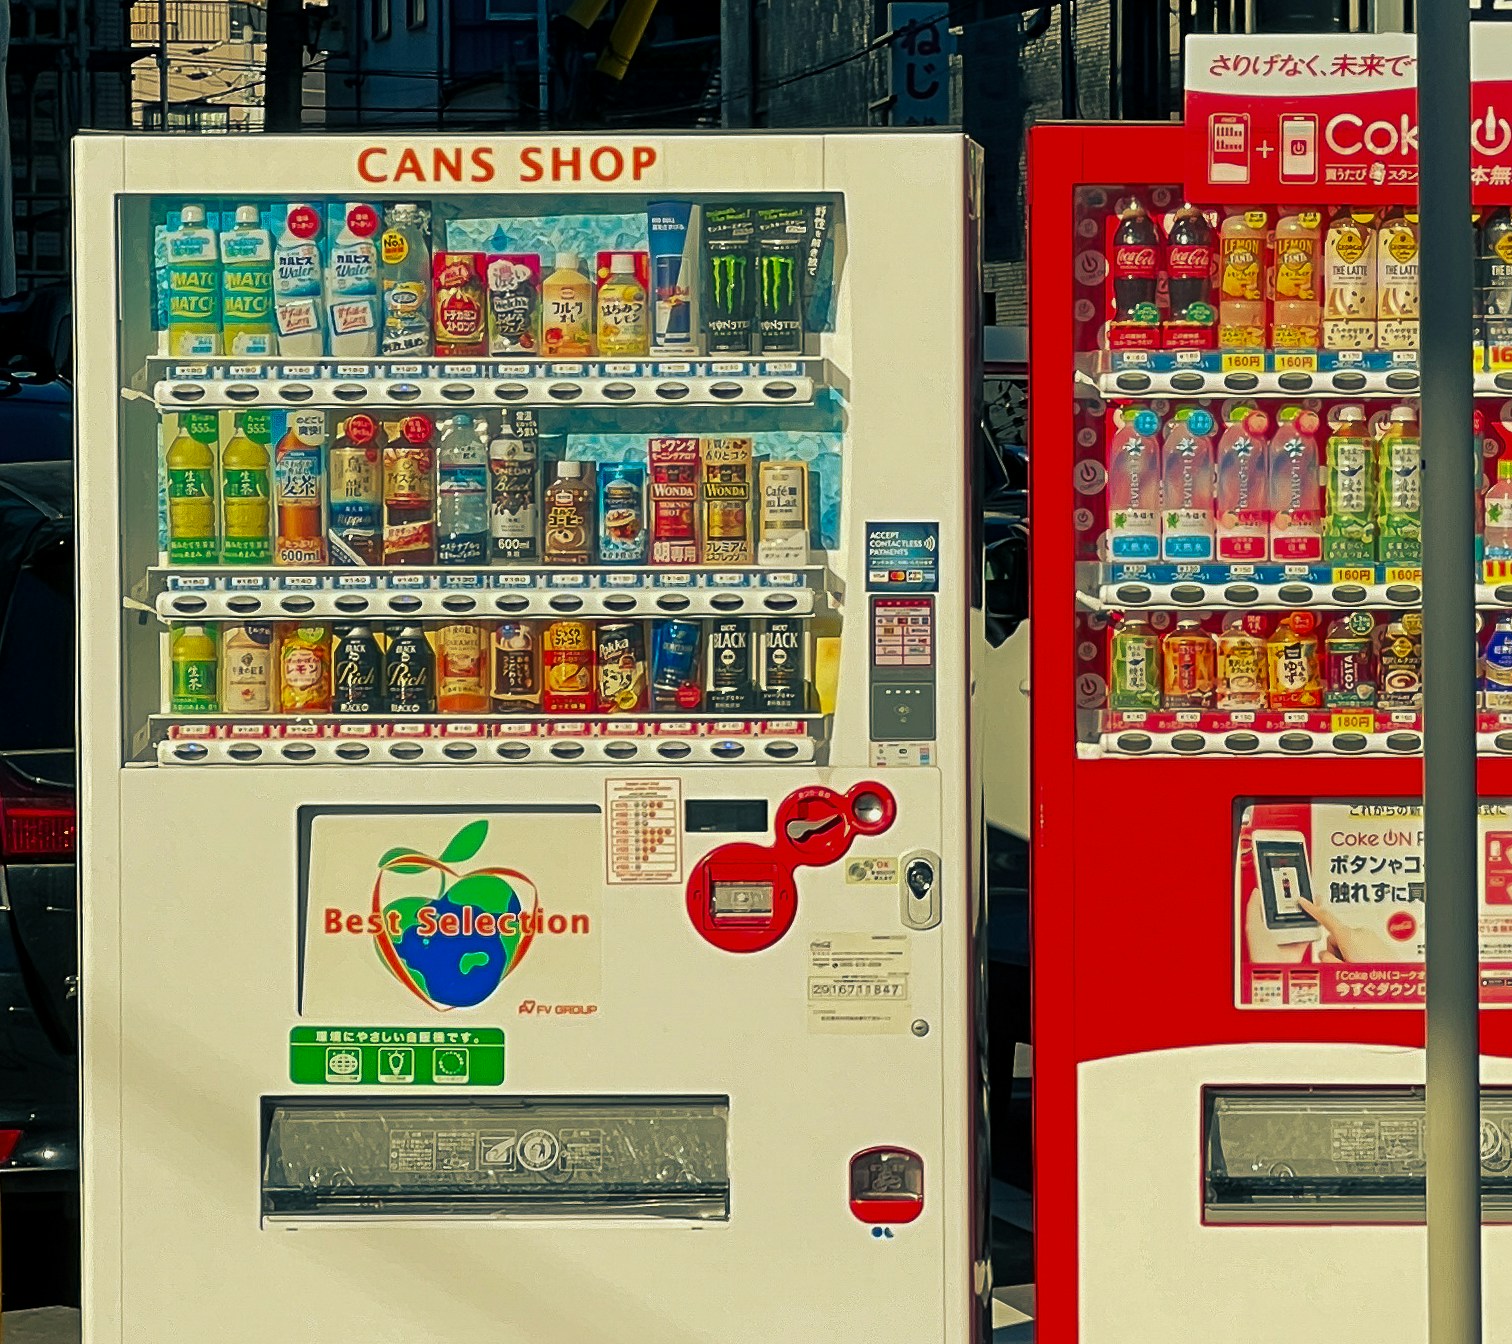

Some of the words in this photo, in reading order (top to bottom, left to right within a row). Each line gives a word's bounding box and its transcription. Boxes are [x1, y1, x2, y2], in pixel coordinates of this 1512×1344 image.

[901, 18, 941, 99] ねじ
[1208, 53, 1417, 78] さりげなく、未来で
[1325, 113, 1419, 156] Cok
[358, 147, 495, 182] CANS
[520, 146, 657, 183] SHOP
[1225, 239, 1259, 253] LEMON
[1279, 239, 1313, 253] LEMON
[279, 256, 314, 265] カルピス
[337, 255, 372, 264] カルピス
[279, 265, 314, 279] Water
[336, 264, 372, 277] Water
[1346, 265, 1367, 276] LATTE
[1399, 265, 1418, 276] LATT
[614, 314, 641, 325] レモン
[1228, 356, 1260, 367] 160円
[1281, 357, 1313, 367] 160円
[653, 486, 694, 496] WONDA
[706, 485, 746, 496] WONDA
[869, 539, 922, 547] CONTACTLESS
[281, 550, 320, 561] 600ml
[869, 548, 909, 556] PAYMENTS
[1337, 570, 1371, 580] 160円
[714, 632, 746, 648] BLACK
[766, 632, 798, 648] BLACK
[338, 662, 375, 684] Rich
[388, 663, 427, 686] Rich
[1345, 655, 1353, 690] COSTA
[1337, 717, 1369, 727] 180円
[1330, 831, 1379, 847] Coke
[1383, 829, 1412, 847] ON
[1329, 855, 1424, 875] ボタンやコ
[324, 907, 401, 935] Best
[417, 906, 590, 936] Selection
[555, 1005, 598, 1014] GROUP
